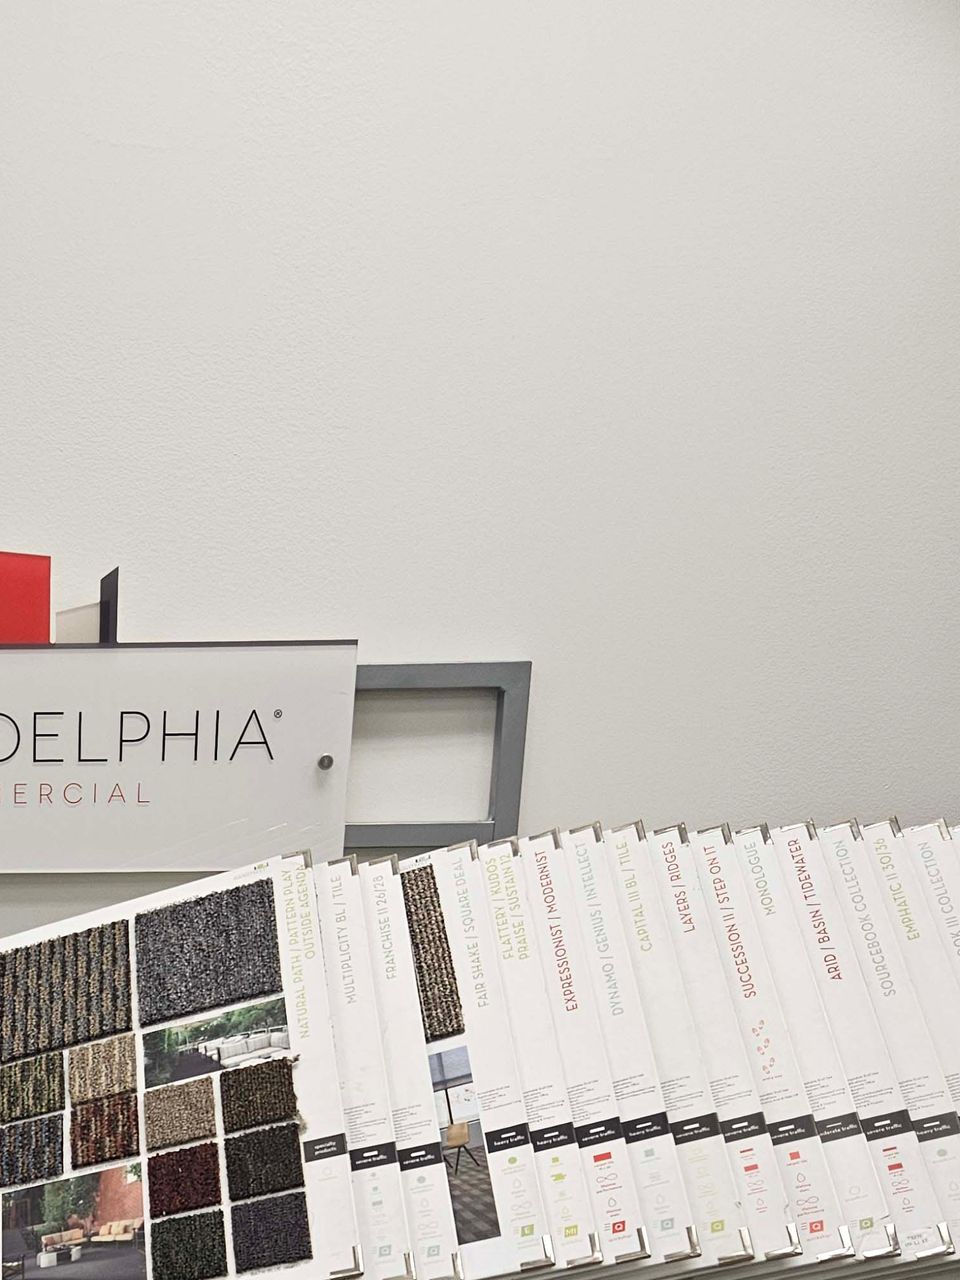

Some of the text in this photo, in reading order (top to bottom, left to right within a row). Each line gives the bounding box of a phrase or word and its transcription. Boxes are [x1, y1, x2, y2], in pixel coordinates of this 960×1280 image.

[616, 840, 632, 866] TILE
[661, 841, 683, 882] RIDGES
[703, 845, 717, 858] IT
[706, 857, 722, 876] ON
[743, 841, 777, 916] MONOLOGUE
[787, 838, 816, 900] TIDEWATER
[872, 838, 895, 872] 30/36
[917, 841, 955, 915] COLLECTION
[372, 874, 387, 906] 26/28
[485, 857, 515, 961] FLATTERY KUDOS
[501, 868, 522, 913] SUSTAIN
[534, 850, 558, 914] MODERNIST
[624, 873, 638, 890] BL
[712, 877, 731, 905] STEP
[295, 864, 316, 960] OUTSIDE AGENDA
[330, 875, 358, 1005] MULTIPLICITY BL TILE
[451, 857, 489, 1009] FAIR SHAKE SQUARE DEAL
[512, 922, 531, 961] PRAISE
[574, 843, 625, 1017] DYNAMO GENIUS INTELLECT
[632, 904, 654, 953] CAPITAL
[674, 890, 696, 934] LAYERS
[809, 907, 831, 945] BASIN
[833, 840, 897, 998] SOURCEBOOK COLLECTION
[889, 883, 921, 942] EMPHATIC
[281, 870, 310, 1040] NATURAL PATH PATTERN PLAY
[377, 916, 398, 980] FRANCHISE
[549, 923, 579, 1013] EXPRESSIONIST
[725, 924, 757, 1000] SUCCESSION
[823, 953, 843, 981] ARID
